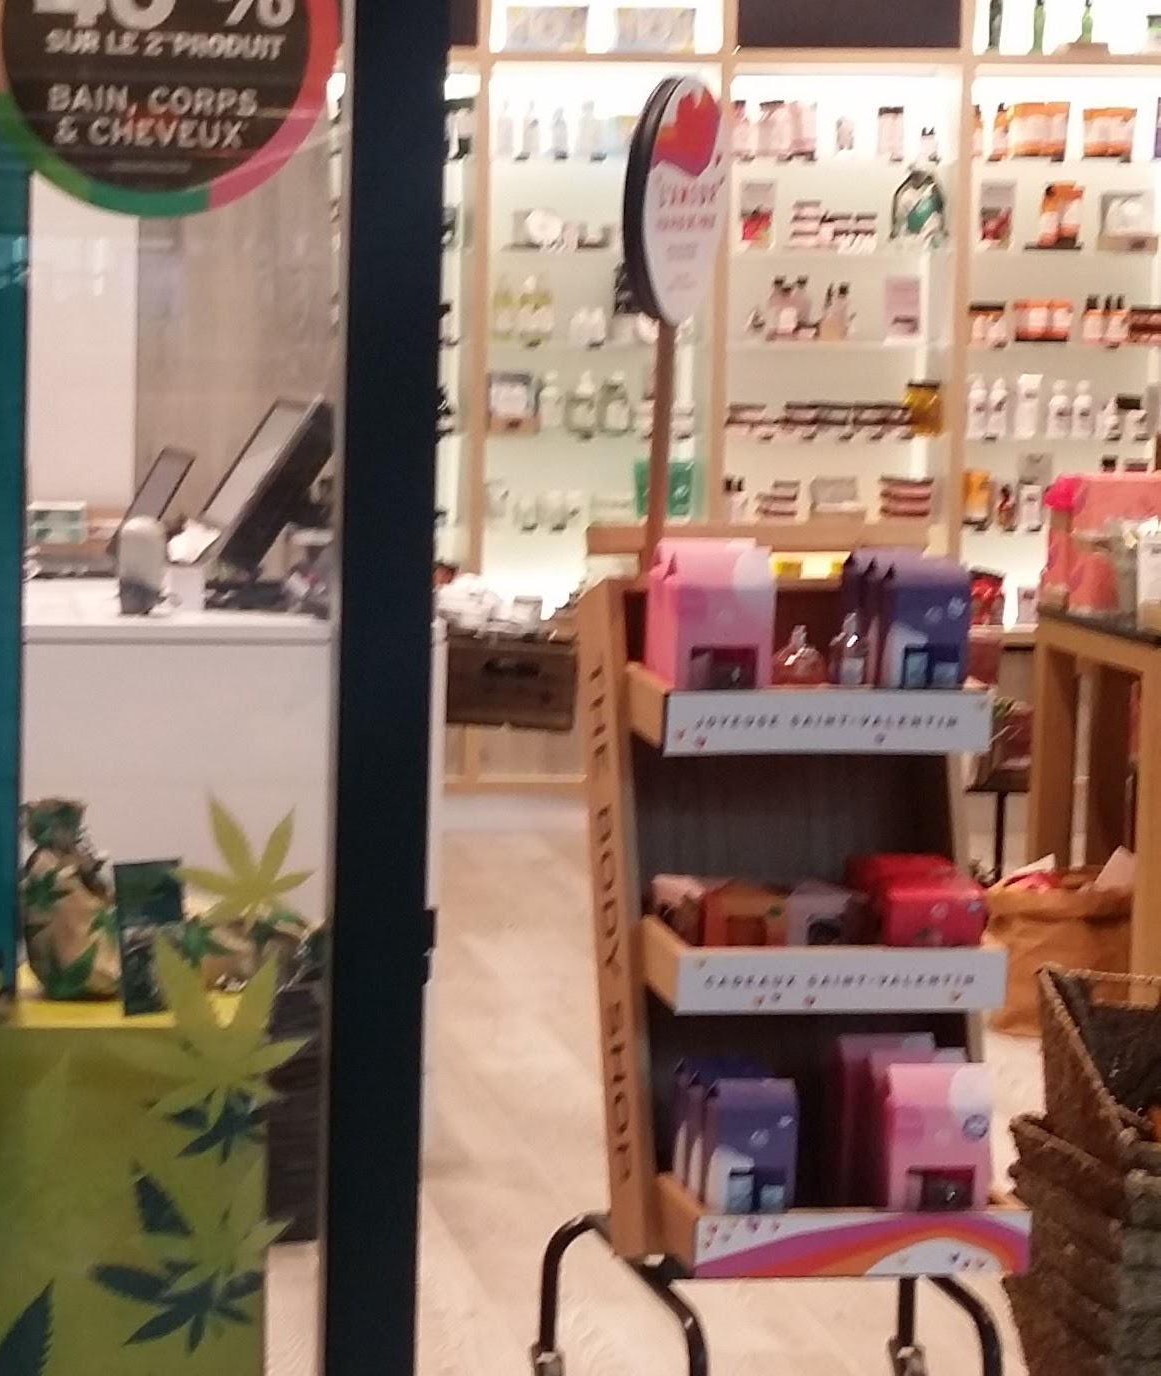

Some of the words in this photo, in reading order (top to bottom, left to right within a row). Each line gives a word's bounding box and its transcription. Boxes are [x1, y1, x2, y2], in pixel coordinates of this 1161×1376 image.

[44, 27, 100, 55] SUR
[104, 30, 140, 55] LE
[172, 32, 286, 61] PRODUIT
[146, 85, 257, 118] CORPS
[87, 118, 247, 149] CHEVEUX
[596, 802, 622, 972] BODY
